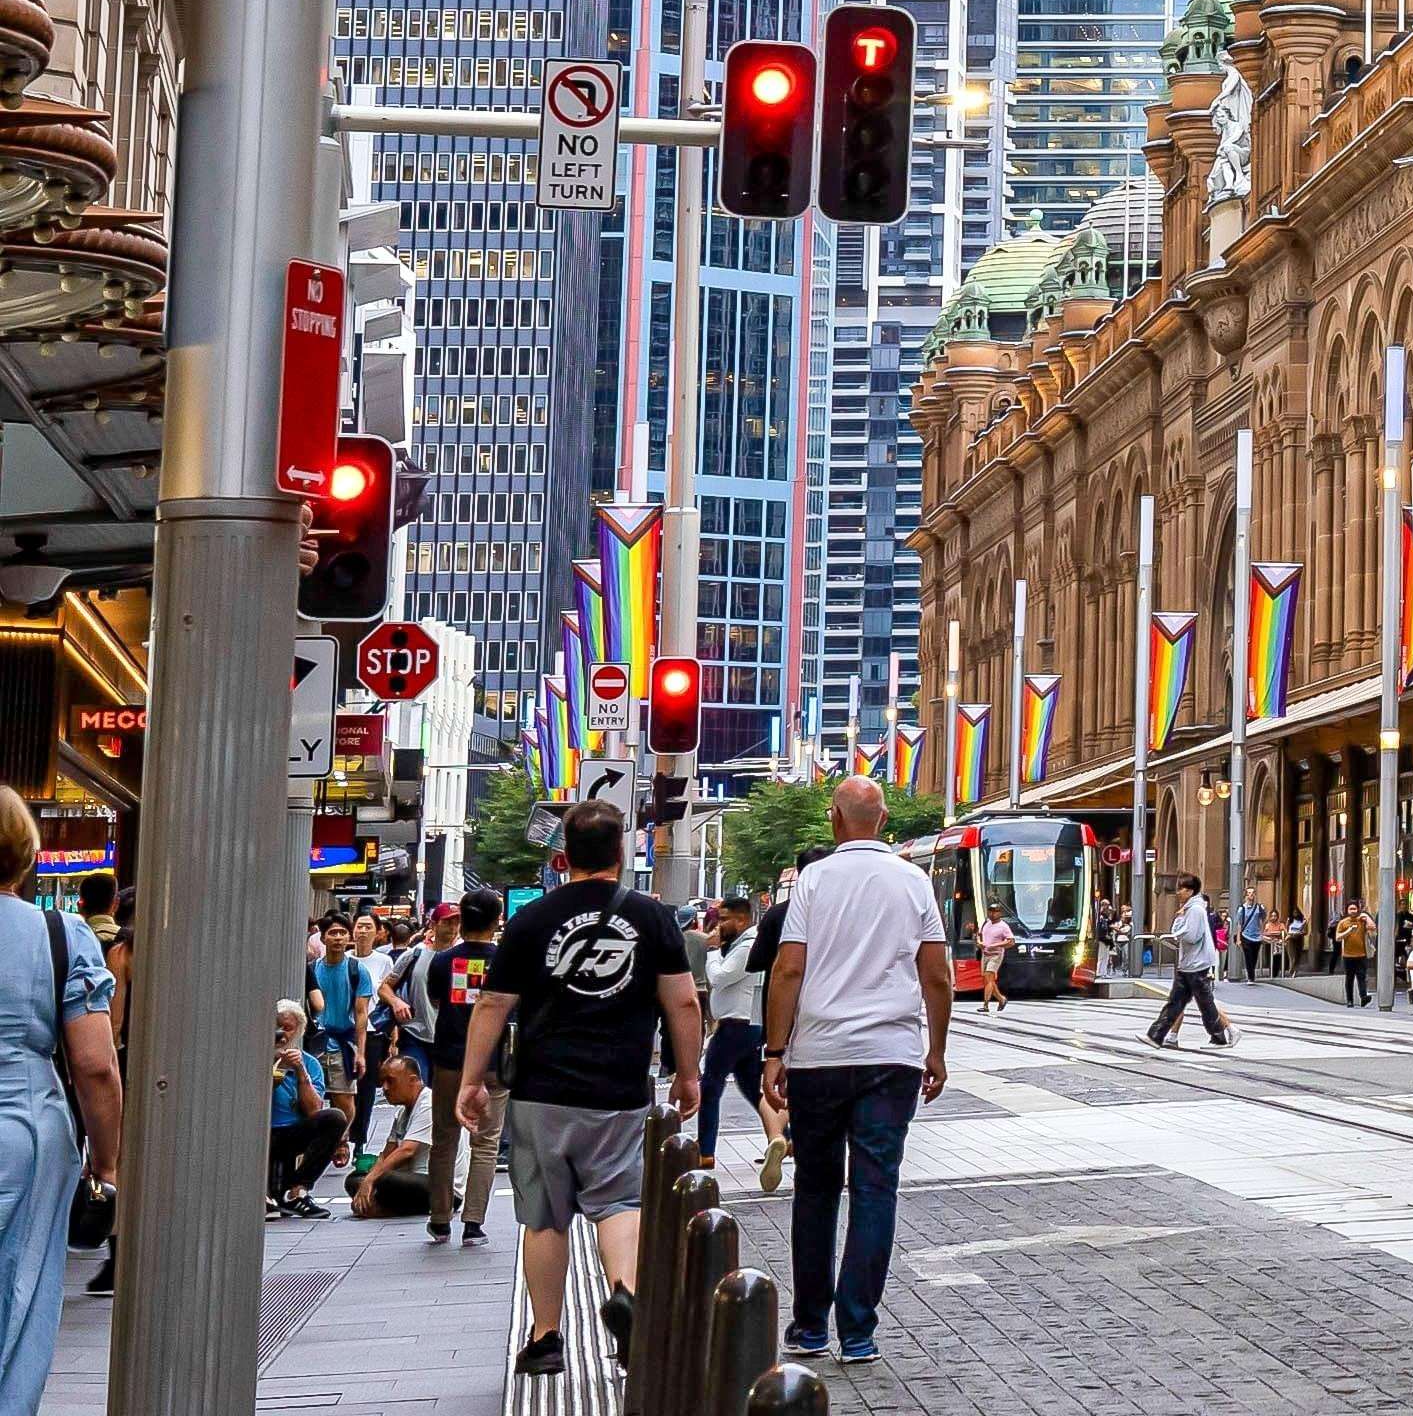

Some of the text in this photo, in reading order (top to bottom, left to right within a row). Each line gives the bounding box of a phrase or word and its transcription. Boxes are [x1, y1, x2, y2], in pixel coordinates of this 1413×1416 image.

[857, 38, 885, 66] T
[557, 133, 599, 157] NO
[551, 162, 603, 179] LEFT
[549, 183, 604, 201] TURN
[366, 648, 431, 675] STOP
[598, 703, 619, 715] NO
[591, 716, 625, 726] ENTRY
